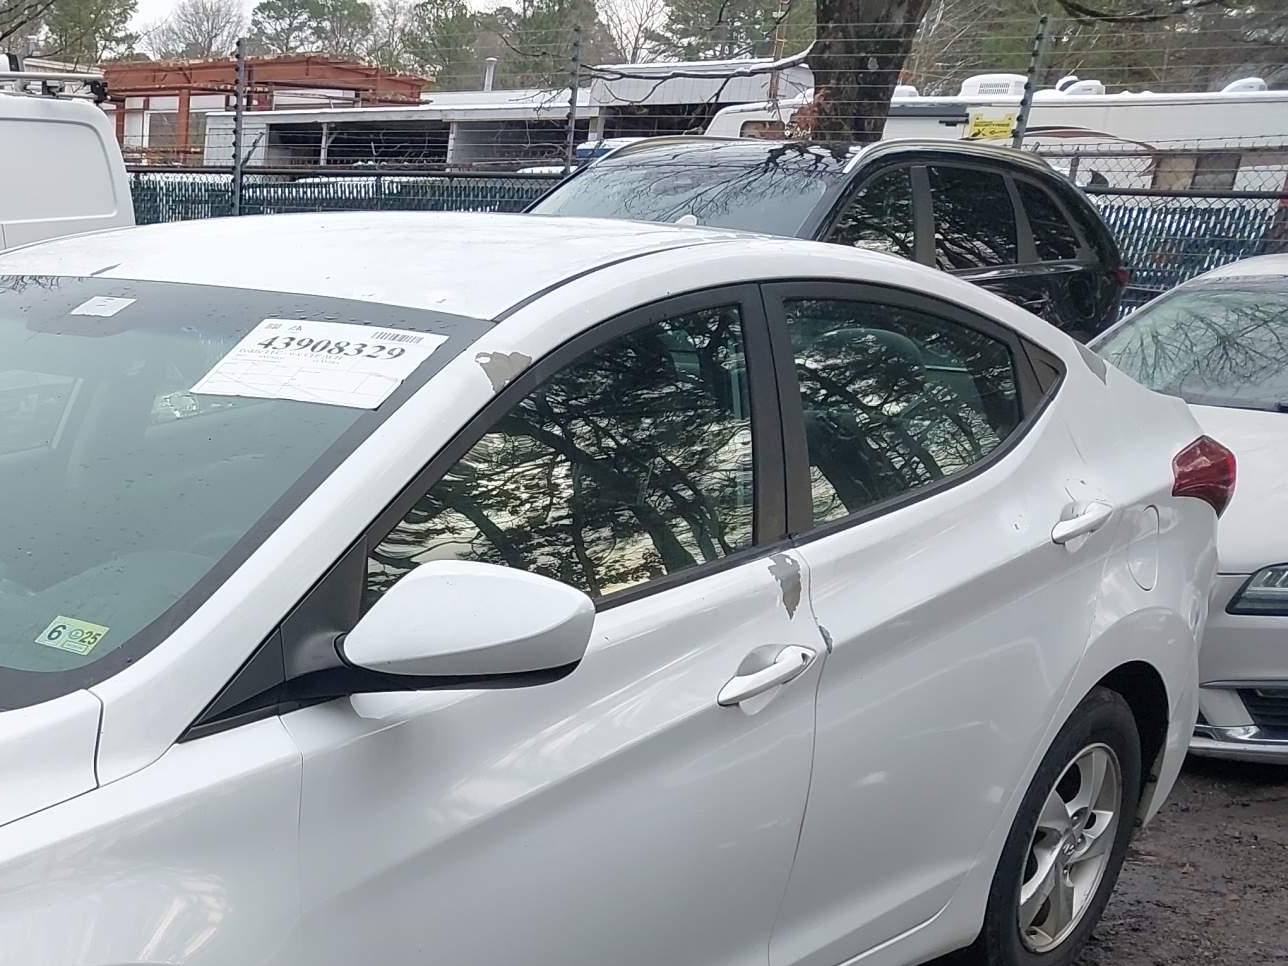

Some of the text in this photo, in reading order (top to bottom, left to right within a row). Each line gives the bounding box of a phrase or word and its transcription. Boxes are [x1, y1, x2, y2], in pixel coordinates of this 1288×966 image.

[257, 335, 405, 360] 43908329
[47, 625, 102, 645] 6 25
